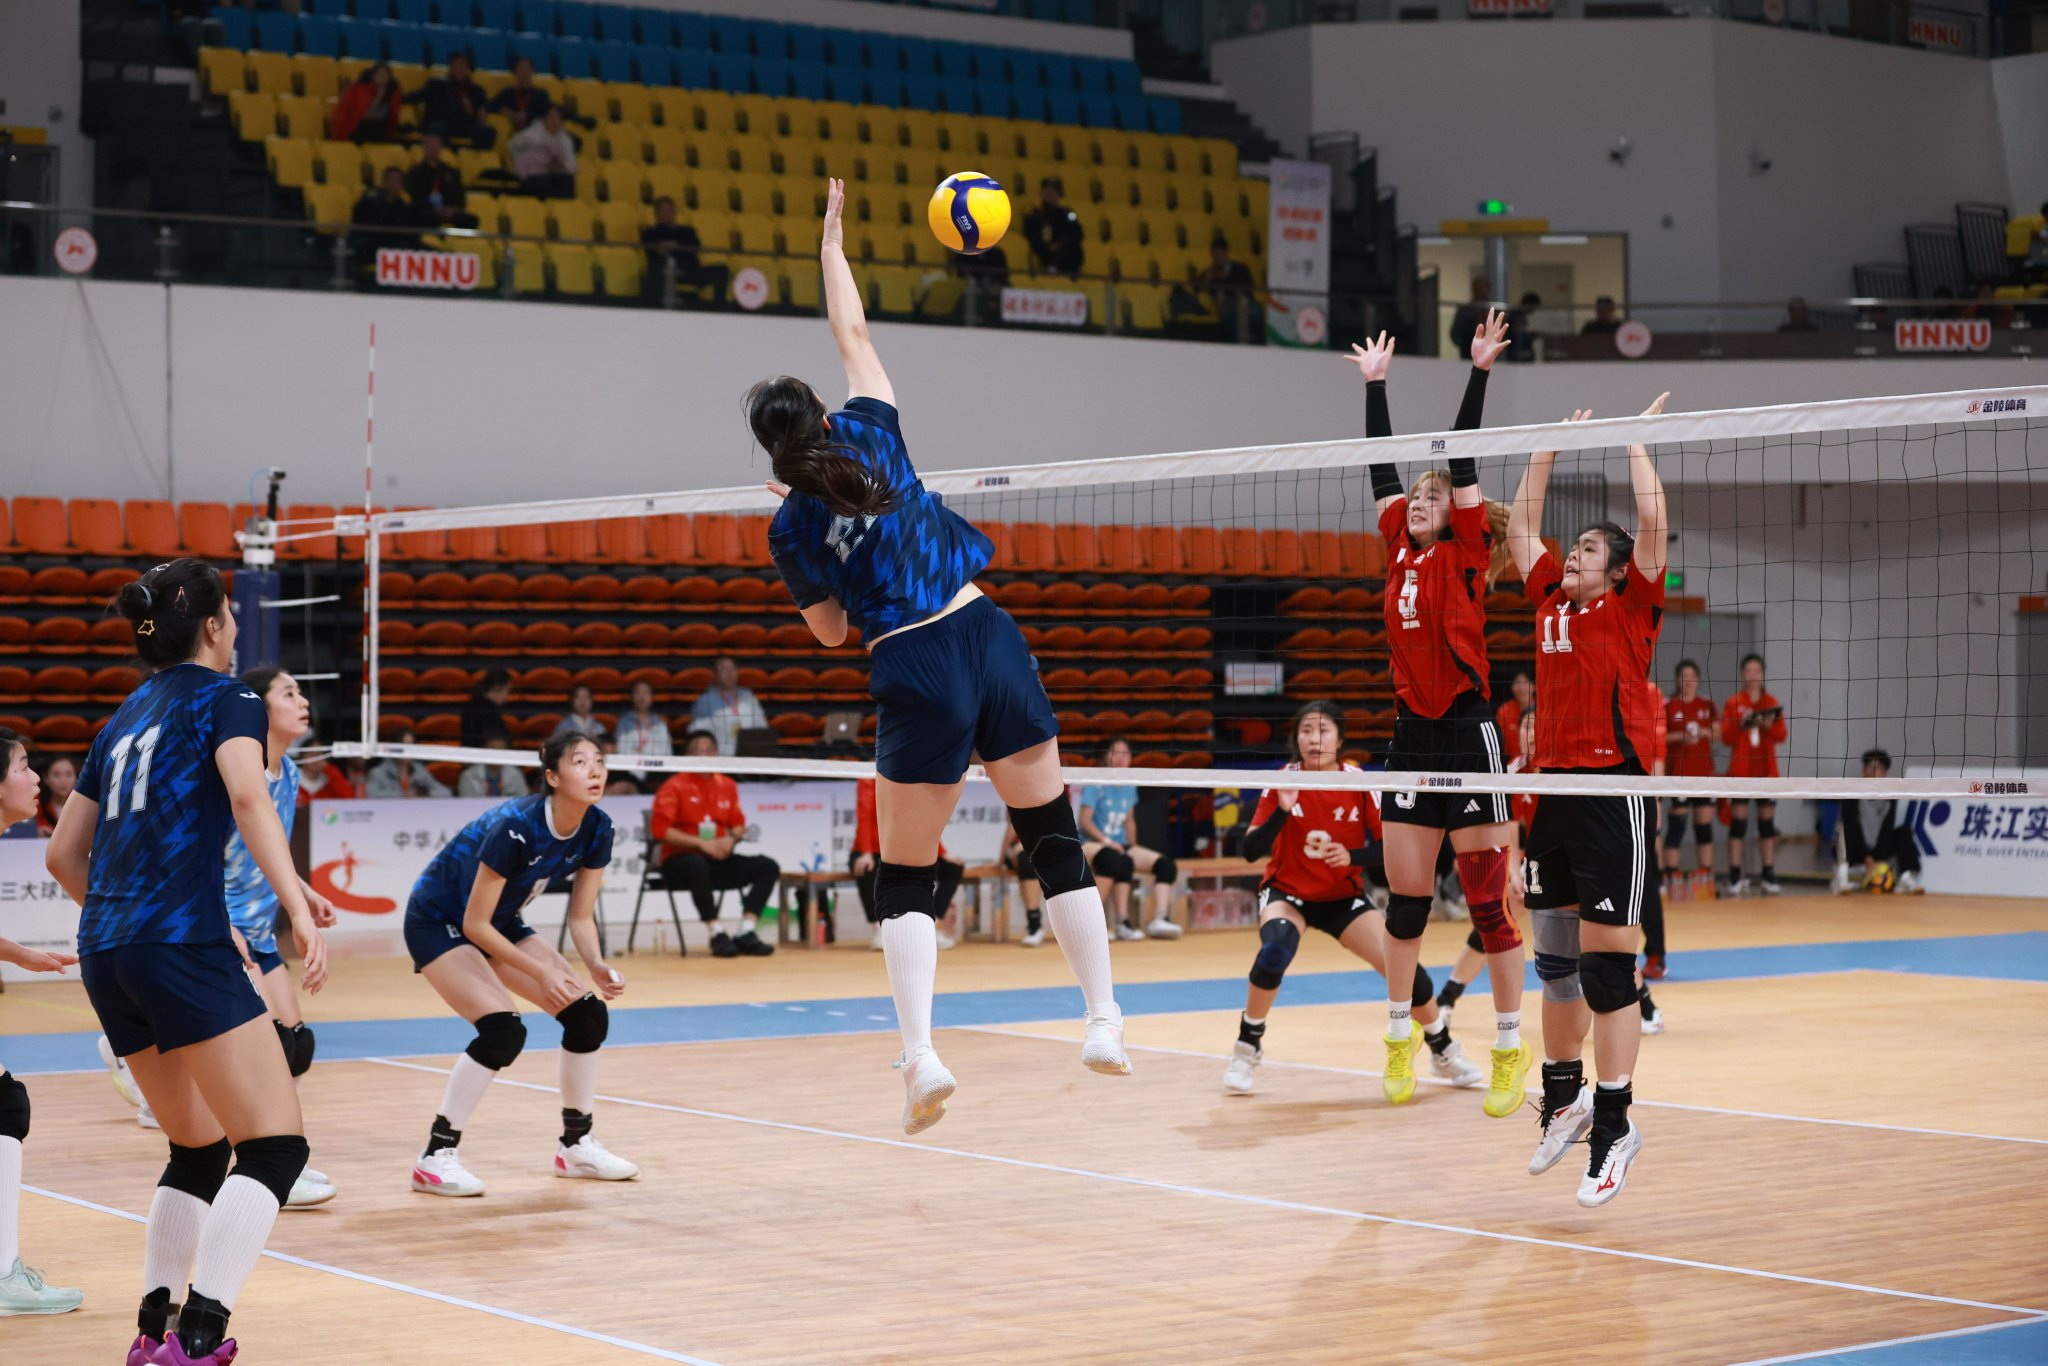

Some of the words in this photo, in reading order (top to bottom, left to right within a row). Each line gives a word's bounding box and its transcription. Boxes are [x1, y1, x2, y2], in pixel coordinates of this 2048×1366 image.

[379, 252, 477, 286] HNNU
[1898, 322, 1988, 349] HNNU
[1982, 399, 2027, 413] 金陵体育
[1398, 569, 1419, 619] 5
[1541, 615, 1573, 653] 11
[106, 723, 162, 821] 11
[1984, 783, 2028, 794] 金陵体育
[1959, 804, 2048, 840] 珠江实
